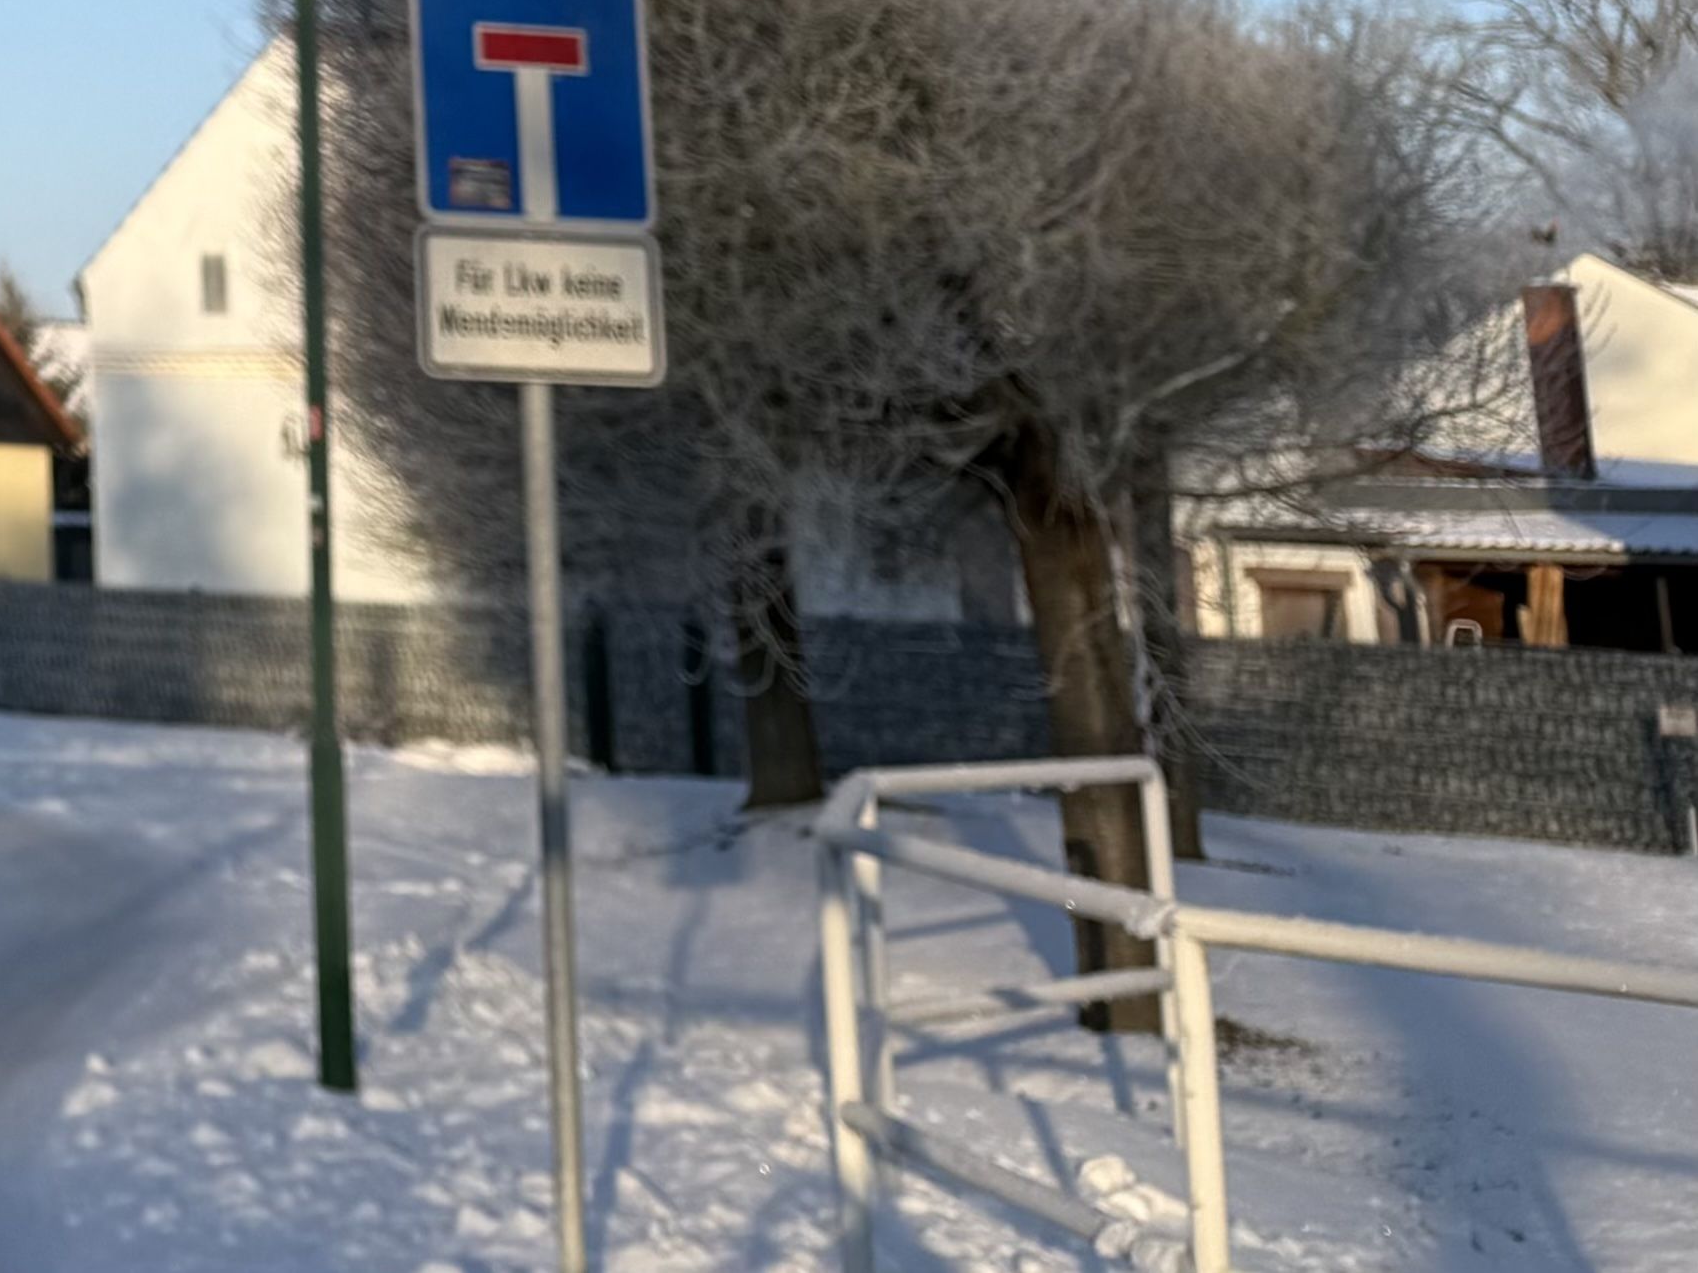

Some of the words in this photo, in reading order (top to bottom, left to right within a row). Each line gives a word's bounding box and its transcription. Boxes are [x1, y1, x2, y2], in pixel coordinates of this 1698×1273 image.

[455, 258, 493, 295] Für
[504, 261, 551, 297] Lkw
[561, 263, 624, 301] keine
[439, 304, 644, 349] Wendemöglichkeit
